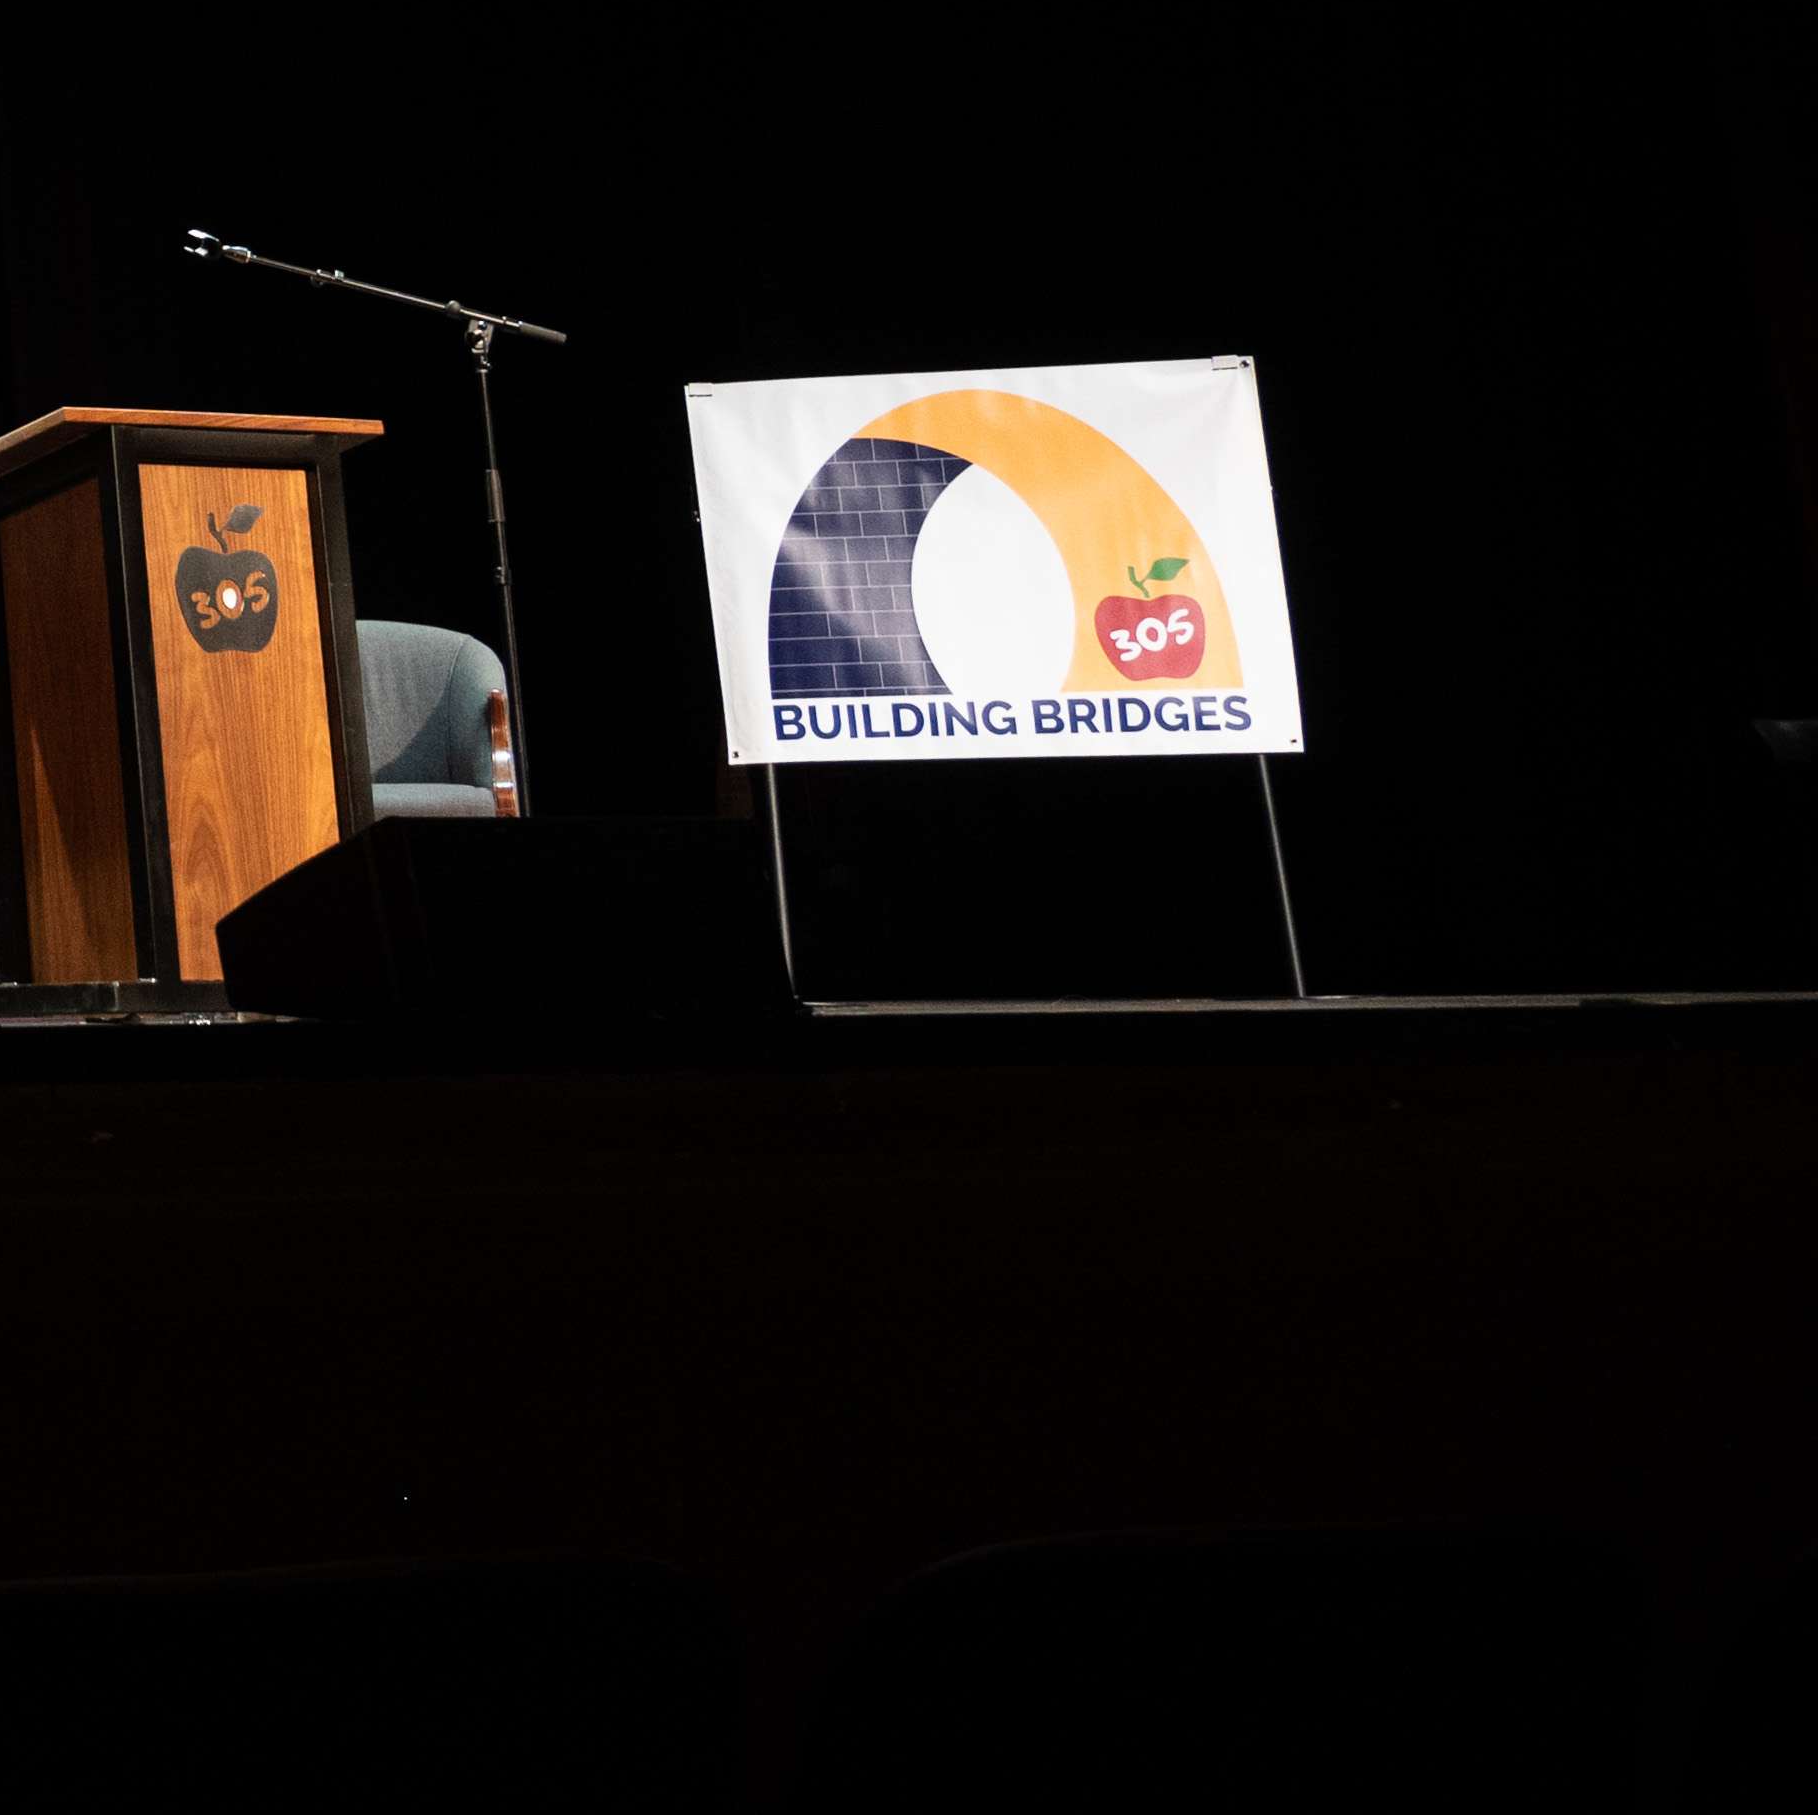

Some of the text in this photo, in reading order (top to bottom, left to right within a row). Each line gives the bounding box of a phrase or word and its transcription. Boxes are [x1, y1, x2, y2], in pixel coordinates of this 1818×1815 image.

[191, 570, 270, 629] 305
[1110, 608, 1194, 661] 305
[772, 695, 1252, 741] BUILDING BRIDGES
